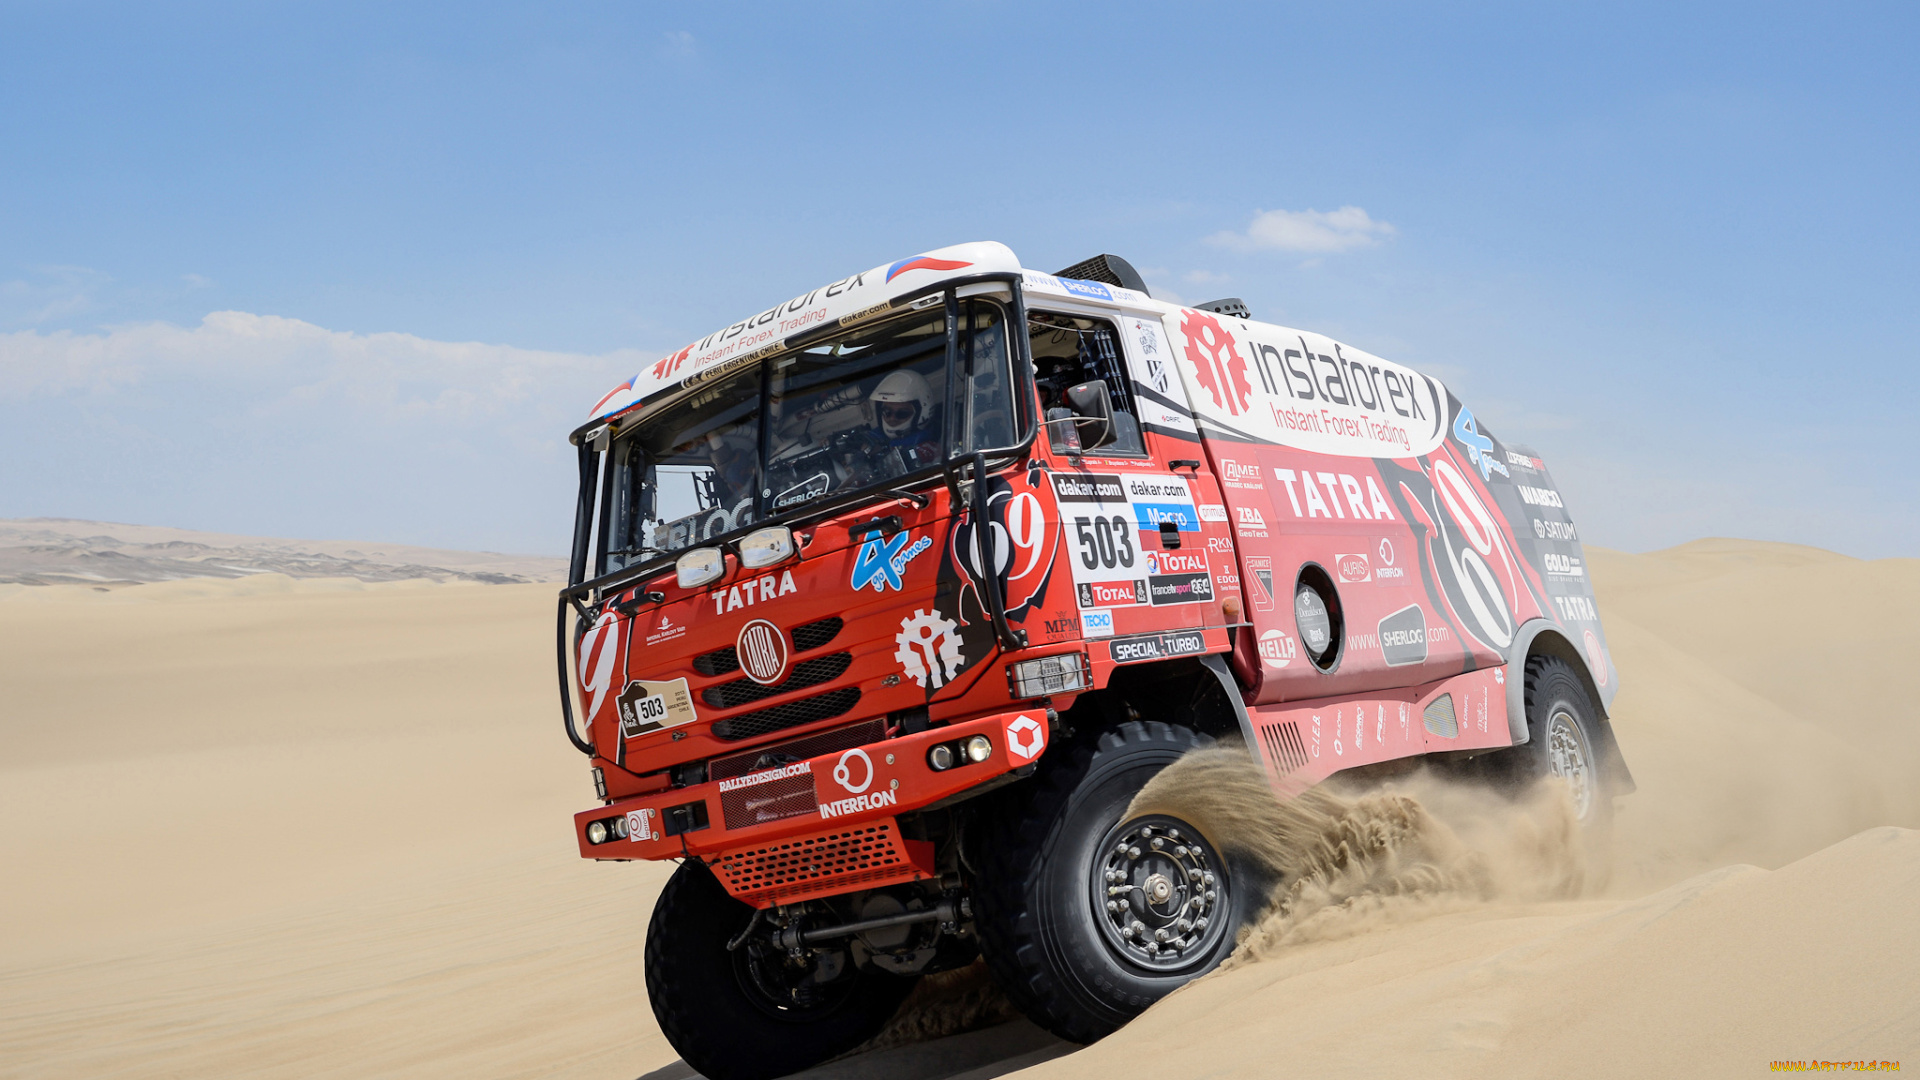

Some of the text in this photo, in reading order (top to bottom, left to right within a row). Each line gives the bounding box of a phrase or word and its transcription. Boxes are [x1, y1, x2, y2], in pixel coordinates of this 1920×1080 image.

[1064, 281, 1108, 297] SHERLOG
[840, 302, 888, 324] dakar.com
[694, 306, 826, 369] Instant Forex Trading
[705, 343, 780, 379] PERU ARGENTINA CHILE
[1240, 324, 1426, 421] instaforex
[1269, 402, 1410, 451] Instant Forex Trading
[1227, 463, 1260, 479] ALMET
[1058, 479, 1122, 498] dakar.com
[1130, 481, 1186, 497] dakar.com
[1274, 468, 1395, 520] TATRA
[1517, 485, 1564, 508] WABCO
[1146, 507, 1187, 527] Macro
[1238, 529, 1269, 538] GeoTech
[1544, 520, 1577, 540] SATUM
[1074, 515, 1134, 570] 503
[892, 536, 933, 576] games
[1159, 552, 1206, 571] TOTAL
[1544, 553, 1570, 572] GOLD
[871, 572, 884, 592] go
[1217, 575, 1238, 583] EDOX
[711, 570, 798, 615] TATRA
[1093, 586, 1134, 601] TOTAL
[1299, 606, 1324, 618] Donaldson
[1555, 596, 1597, 620] TATRA
[1044, 618, 1079, 633] MPM
[1084, 614, 1110, 627] TECHO
[1116, 636, 1200, 659] SPECIAL TURBO
[1258, 637, 1296, 659] HELLA
[1348, 626, 1450, 650] www. SHERLOG .com
[743, 625, 781, 678] TATRA
[640, 698, 663, 719] 503
[719, 762, 812, 792] RALLYEDESIGN.COM
[819, 790, 897, 819] INTERFLON
